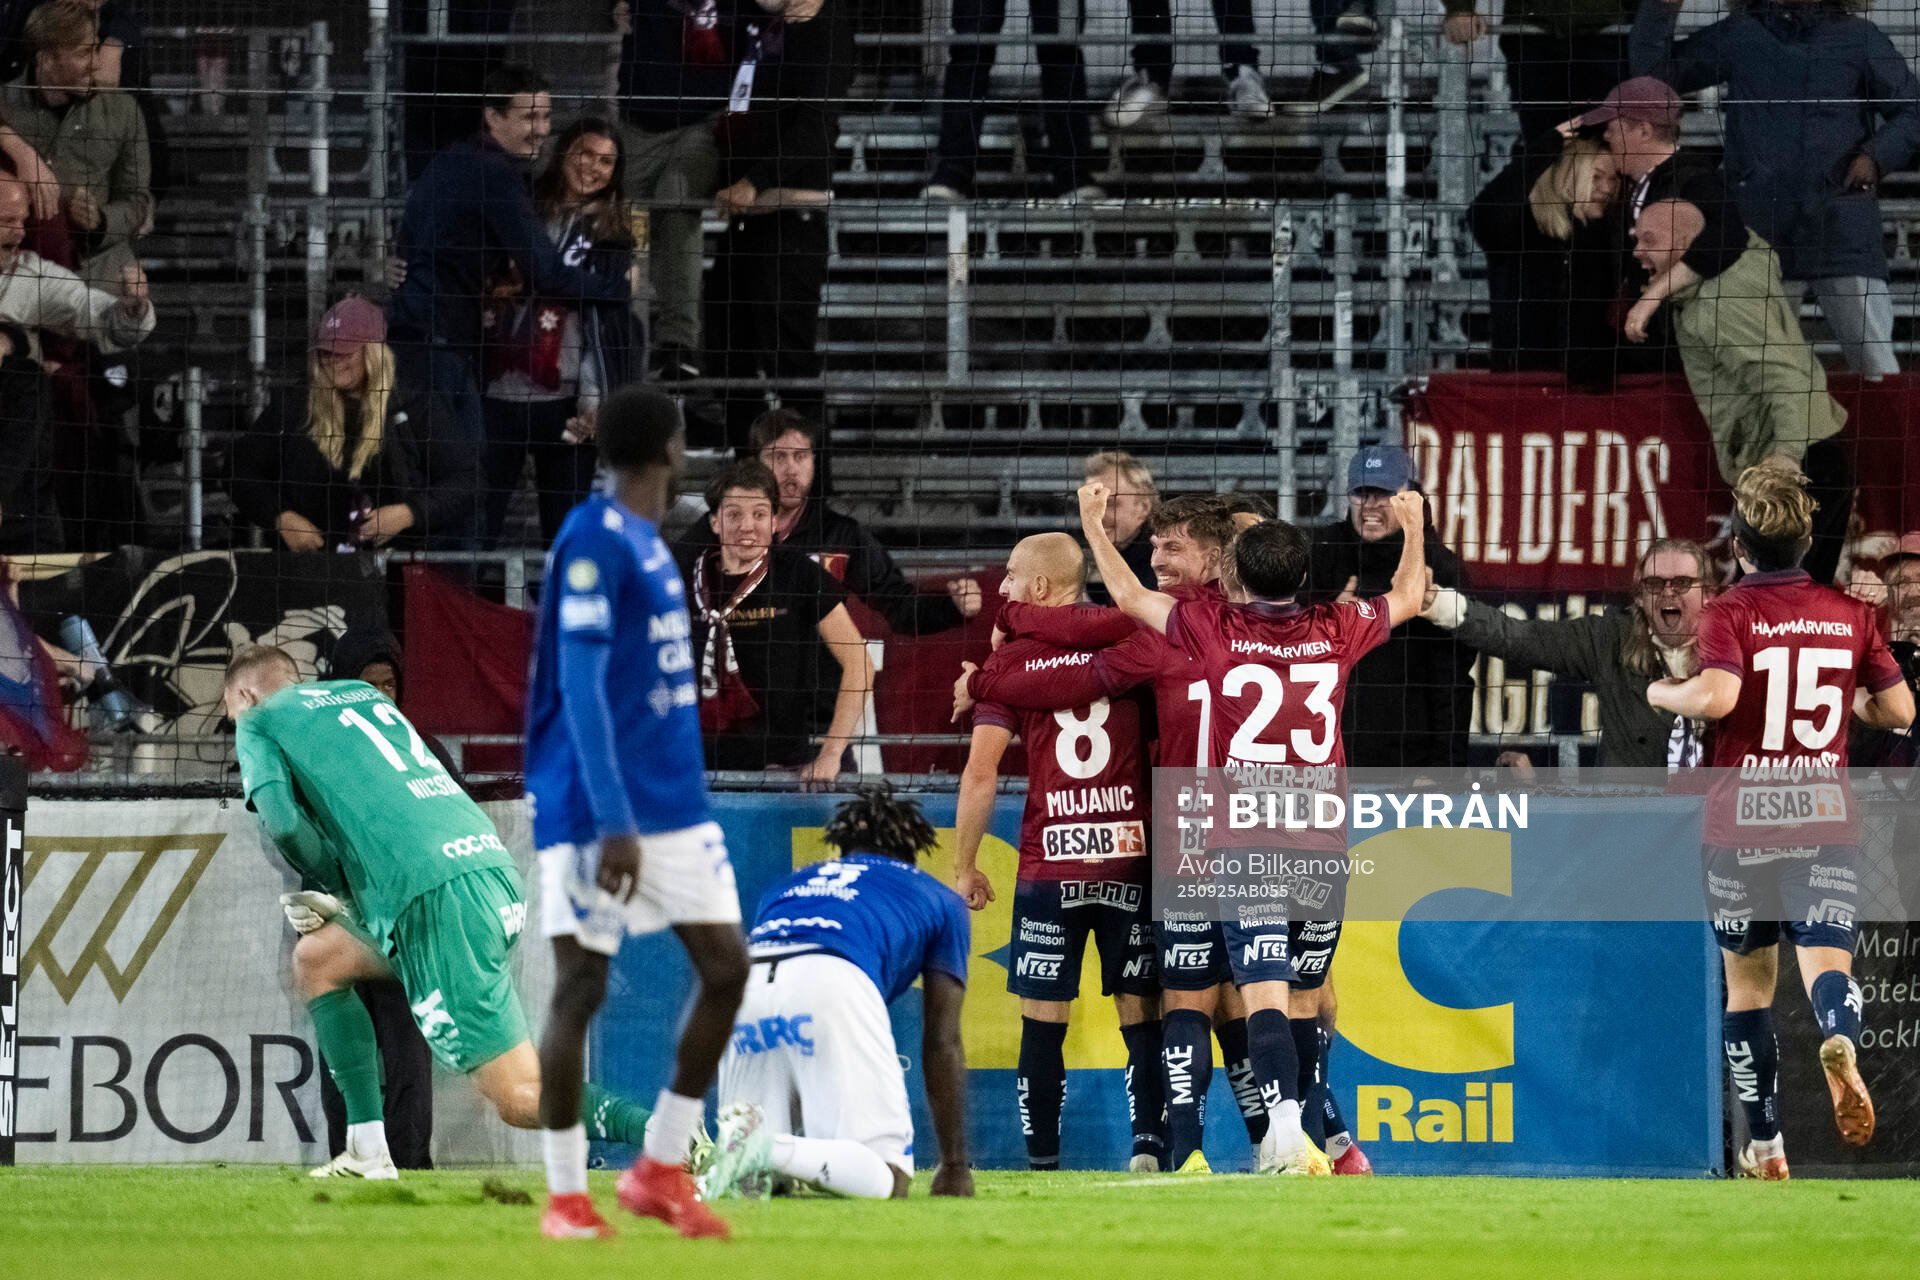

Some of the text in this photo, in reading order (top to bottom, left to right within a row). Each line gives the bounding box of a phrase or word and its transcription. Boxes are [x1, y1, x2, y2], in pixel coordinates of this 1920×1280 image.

[1222, 663, 1338, 764] 23
[1753, 647, 1853, 751] 15
[338, 703, 443, 772] 12
[1053, 696, 1111, 779] 8
[1046, 785, 1134, 818] MUJANIC
[1741, 790, 1814, 820] BESAB
[1047, 828, 1115, 857] BESAB
[1060, 881, 1143, 907] DEMO
[1, 819, 22, 1137] SELECT
[1016, 952, 1065, 980] NTEX
[1164, 942, 1213, 969] NTEX
[1165, 1045, 1194, 1105] MIKE
[1230, 1057, 1264, 1118] MIKE
[1725, 1041, 1759, 1102] MIKE
[1357, 1082, 1514, 1142] Rail
